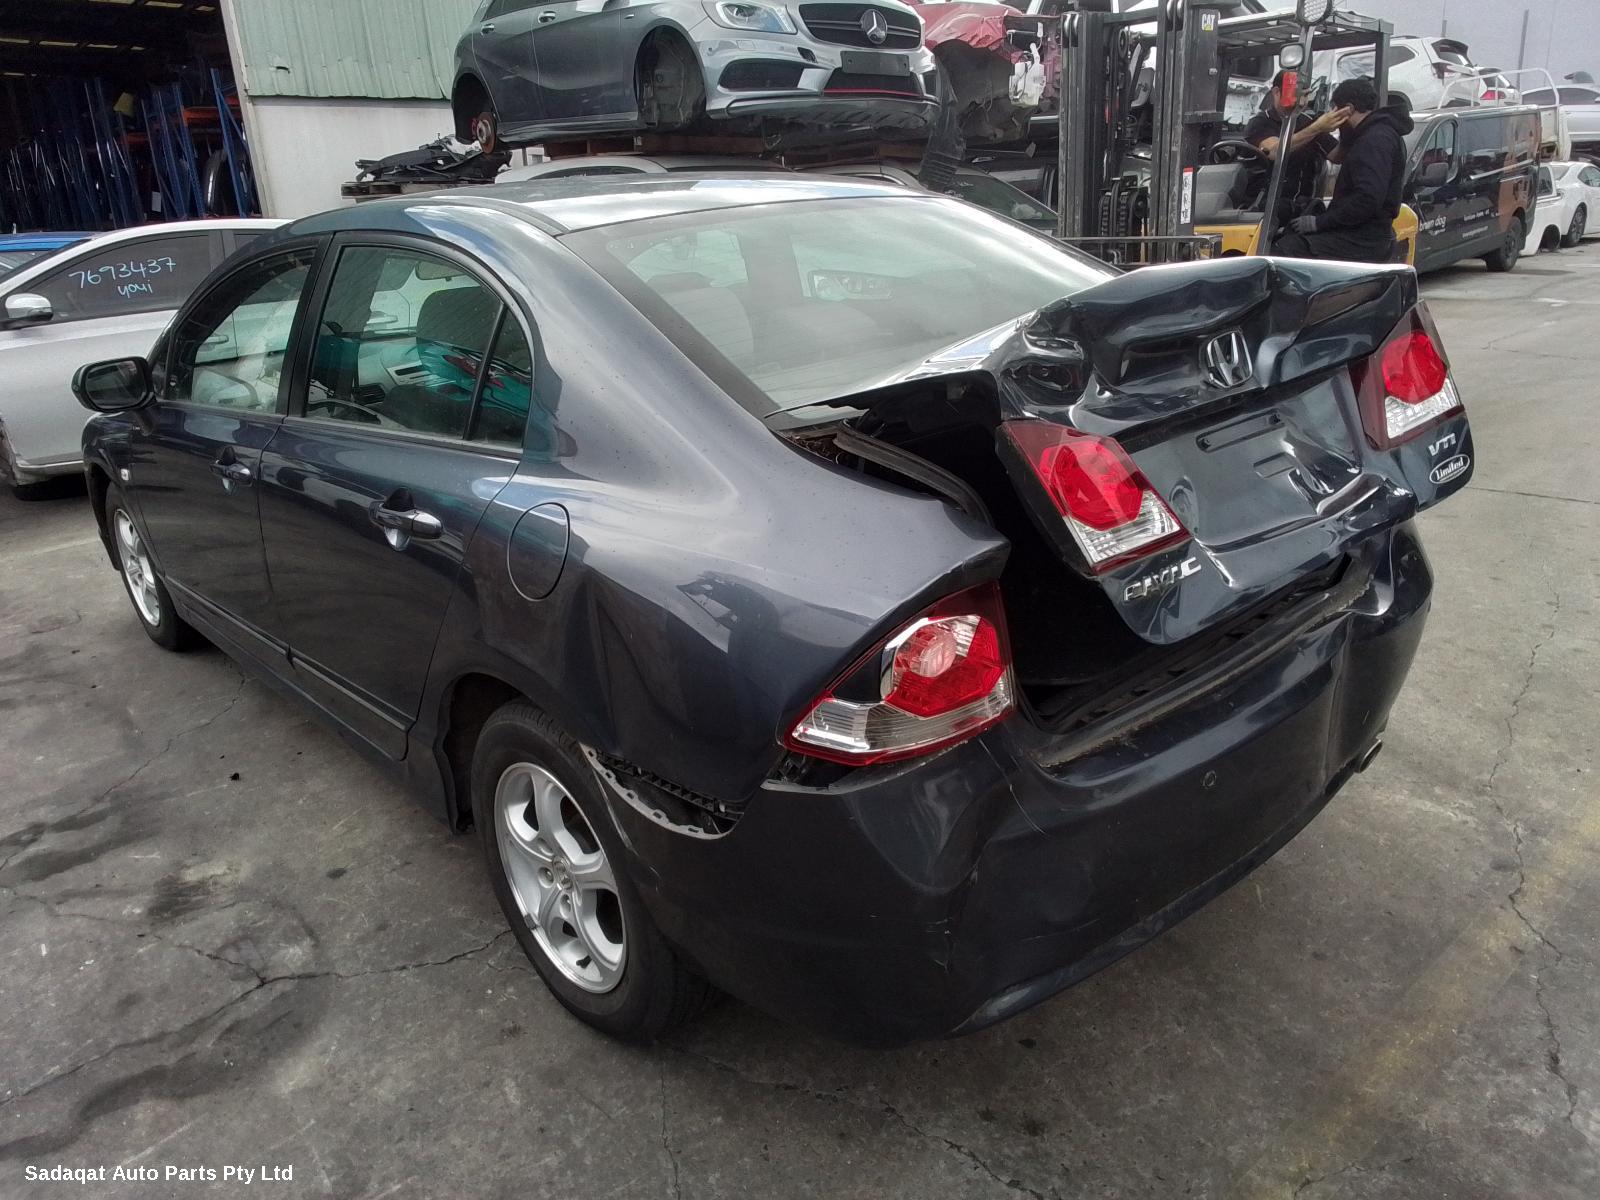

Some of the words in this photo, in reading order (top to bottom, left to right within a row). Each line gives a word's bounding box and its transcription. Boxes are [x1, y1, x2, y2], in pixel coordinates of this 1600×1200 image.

[1202, 13, 1216, 31] CAT
[68, 256, 176, 289] 7693437
[1123, 556, 1202, 601] CIVIC
